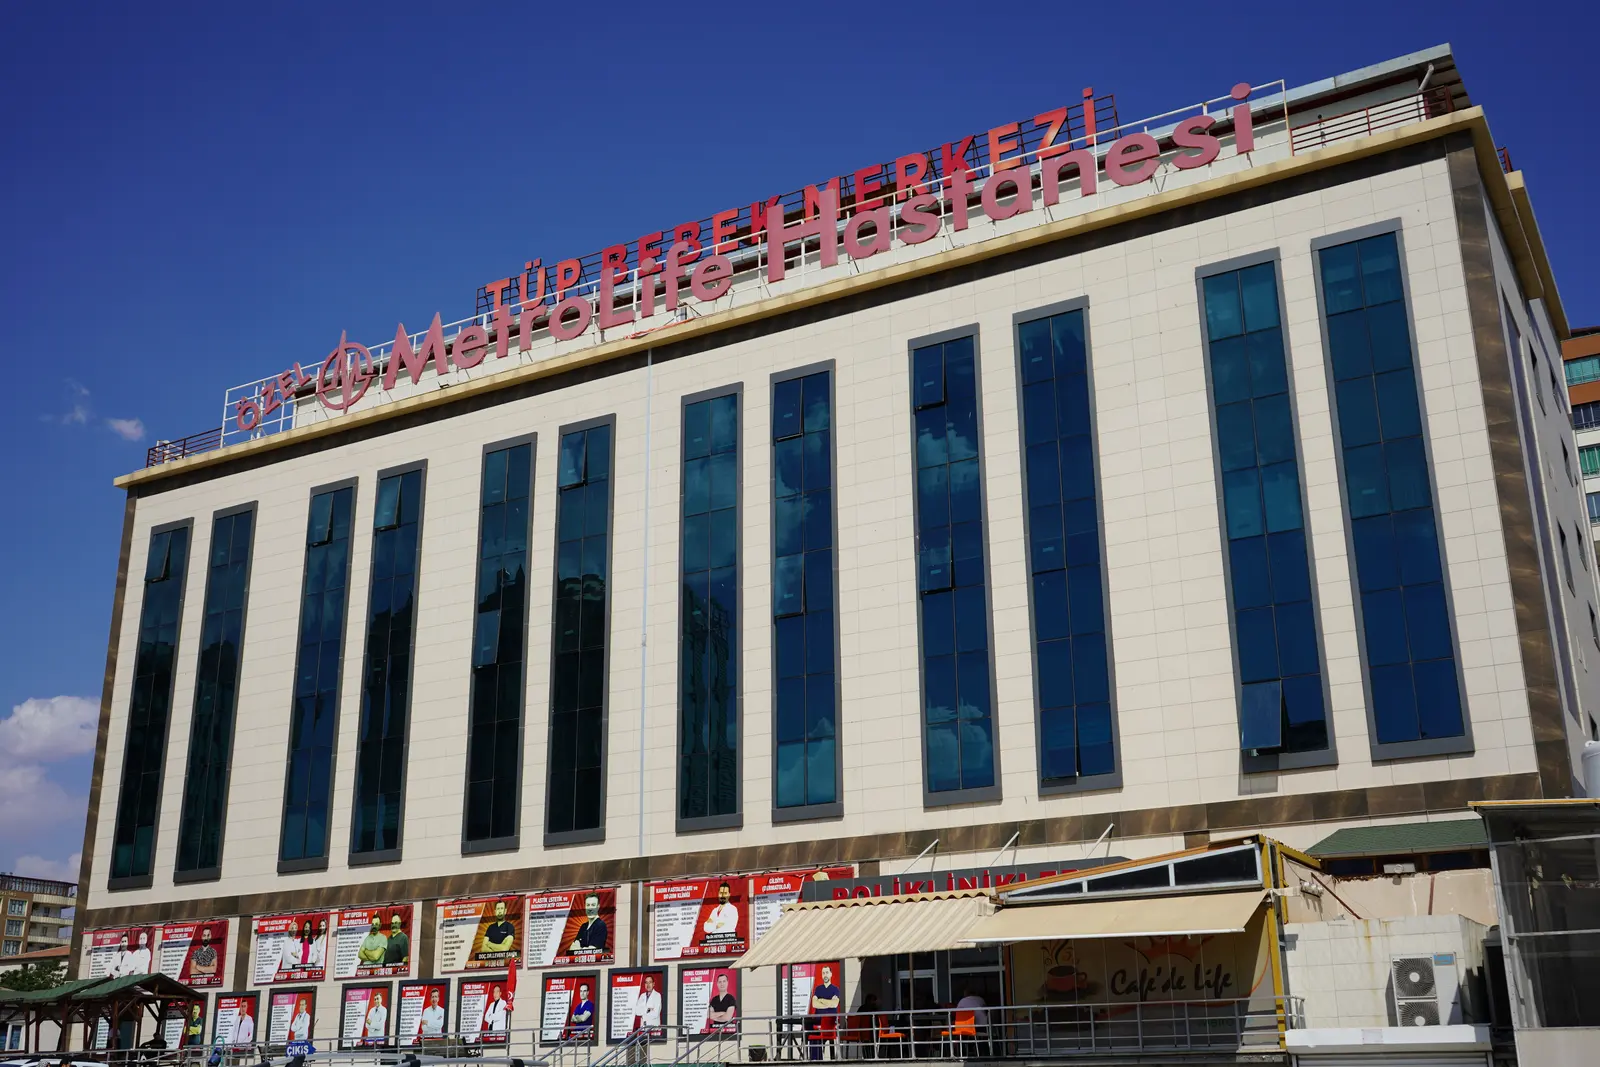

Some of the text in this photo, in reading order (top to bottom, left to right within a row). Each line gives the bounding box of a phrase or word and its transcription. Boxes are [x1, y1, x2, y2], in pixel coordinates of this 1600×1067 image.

[236, 82, 1255, 431] ÖZEL MetroLife Hastanesi
[486, 87, 1096, 320] TÜP BEBEK MERKEZİ
[1194, 964, 1232, 1000] Life
